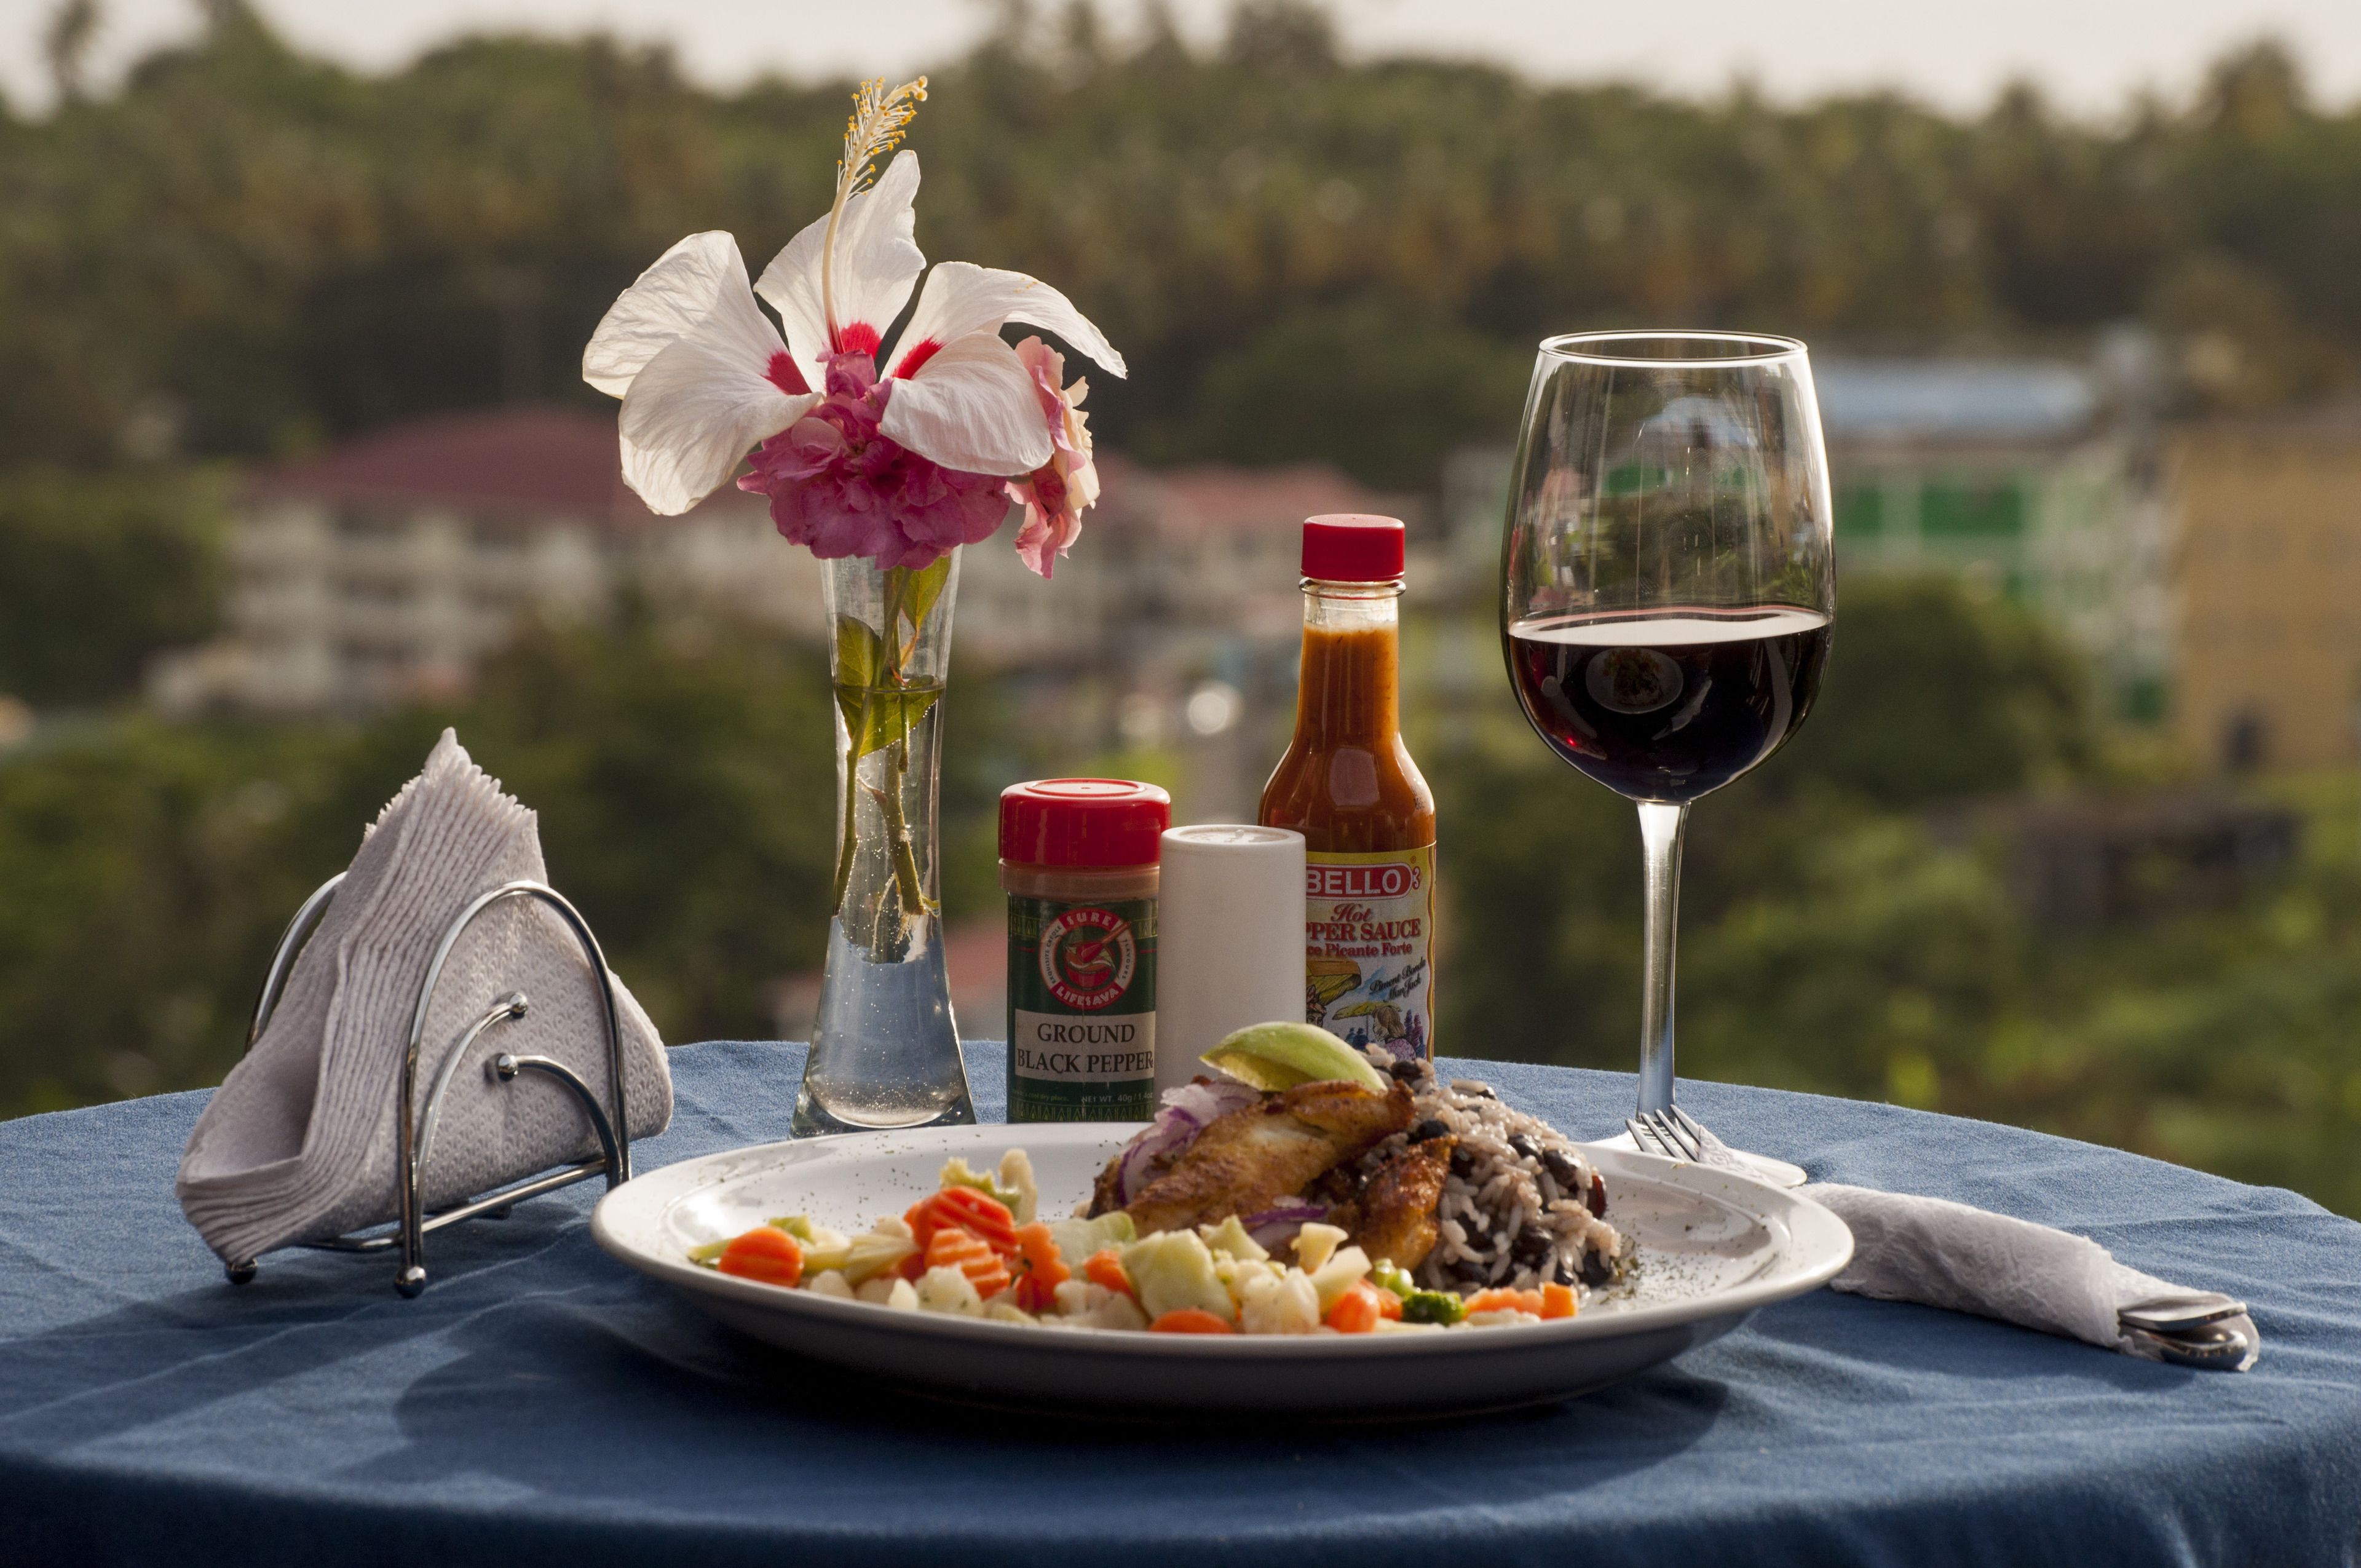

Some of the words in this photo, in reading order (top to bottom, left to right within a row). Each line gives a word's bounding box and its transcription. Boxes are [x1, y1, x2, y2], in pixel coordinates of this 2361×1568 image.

[1066, 912, 1112, 925] SURE
[1330, 903, 1372, 922] Hot
[1046, 925, 1062, 947] CREOLE
[1361, 918, 1422, 941] SAUCE
[1122, 938, 1132, 980] FLAVOURS
[1324, 943, 1379, 957] Picante
[1382, 941, 1412, 956] Forte
[1045, 950, 1056, 984] EXQUISITE
[1056, 988, 1119, 1006] LIFESAVA
[1037, 1023, 1135, 1043] GROUND
[1017, 1048, 1081, 1074] BLACK
[1086, 1050, 1153, 1072] PEPPER
[1117, 1094, 1132, 1103] 40g
